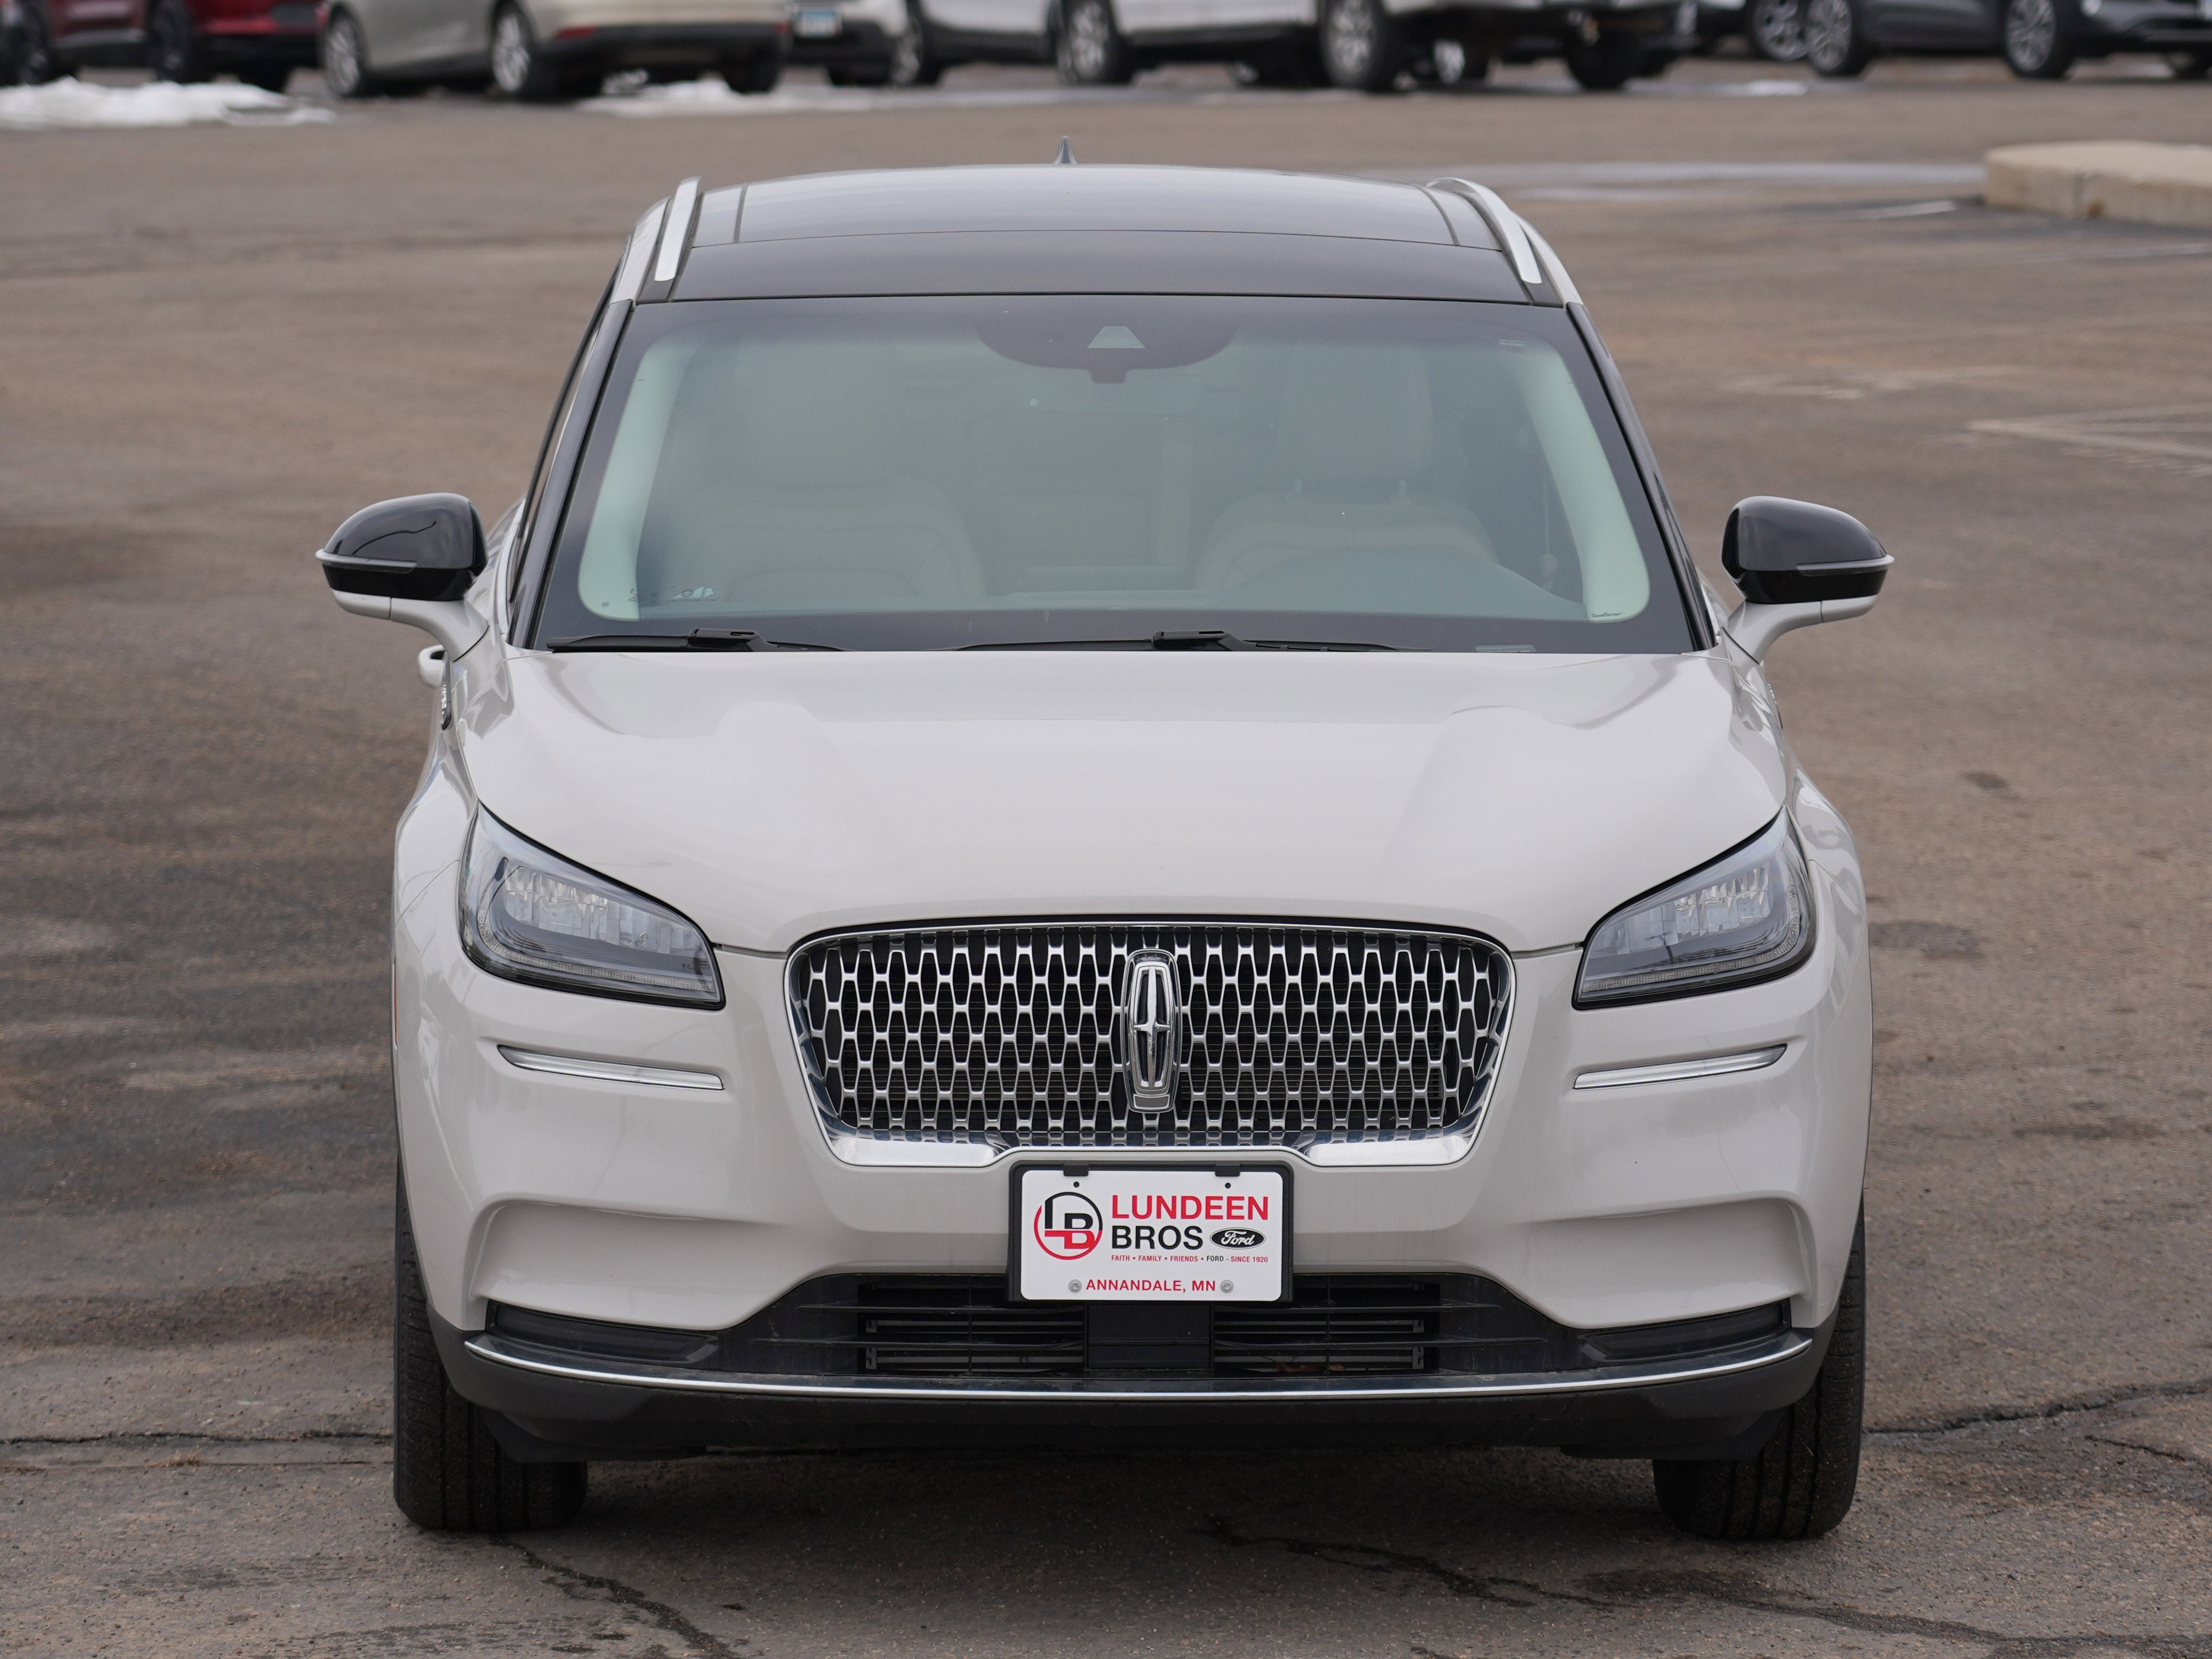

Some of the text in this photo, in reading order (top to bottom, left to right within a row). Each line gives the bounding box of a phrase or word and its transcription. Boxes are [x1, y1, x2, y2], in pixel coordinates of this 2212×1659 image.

[1112, 1195, 1269, 1220] LUNDEEN
[1111, 1225, 1204, 1250] BROS
[1220, 1230, 1255, 1246] Ford
[1085, 1279, 1216, 1293] ANNANDALE, MN
